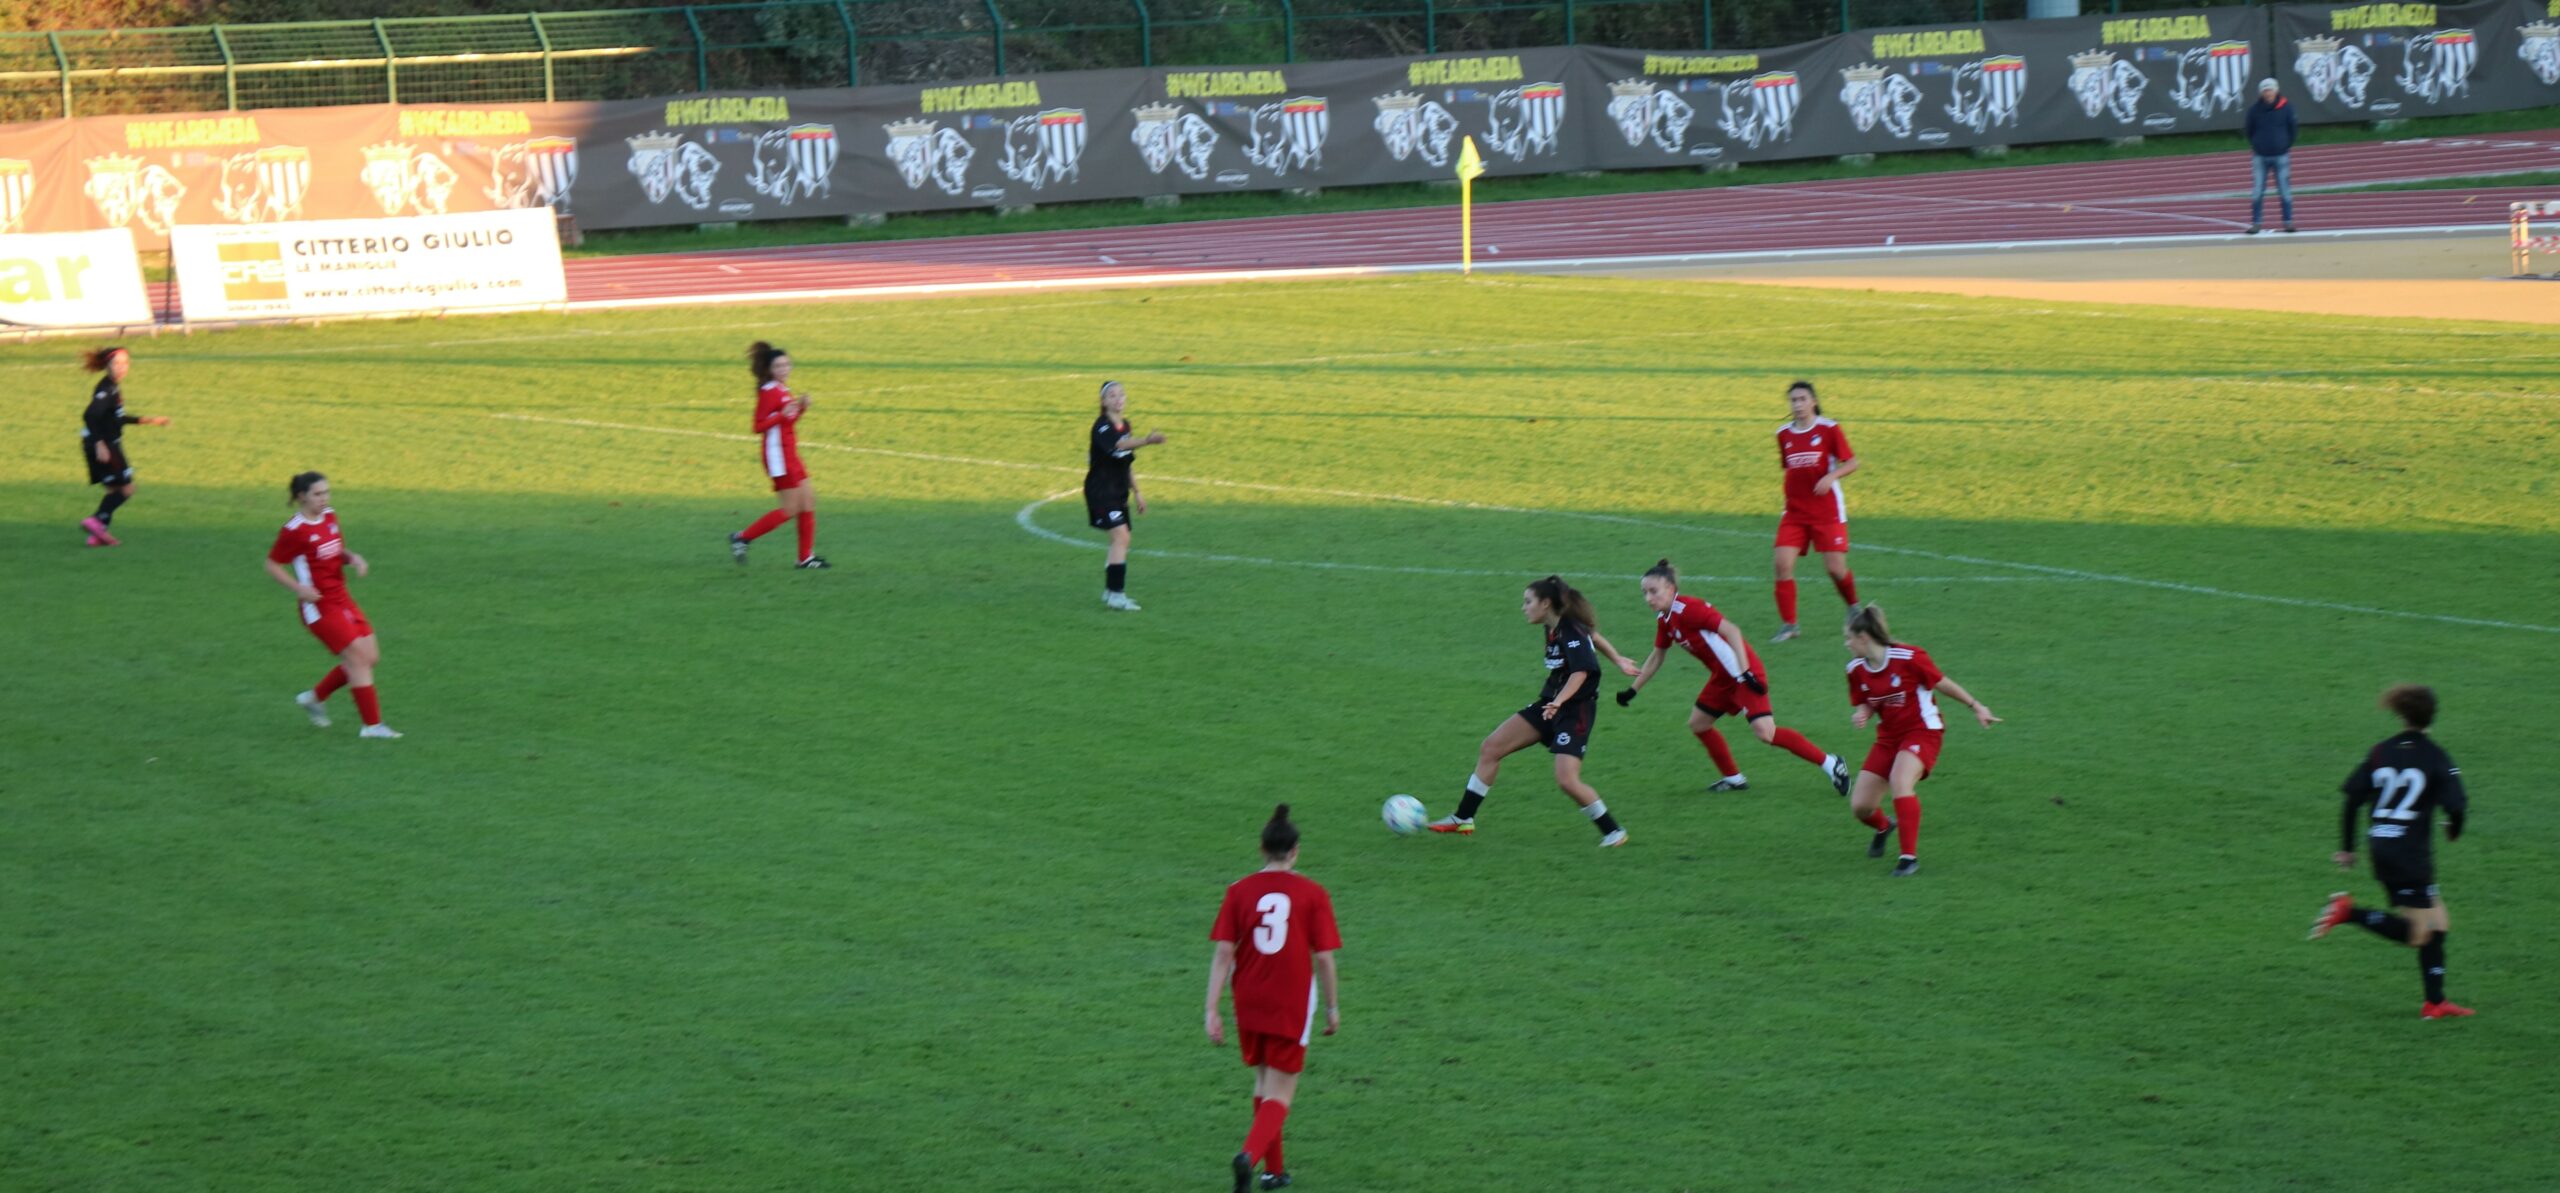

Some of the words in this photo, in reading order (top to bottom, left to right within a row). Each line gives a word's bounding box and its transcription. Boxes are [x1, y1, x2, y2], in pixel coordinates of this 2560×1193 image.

[294, 236, 410, 256] CITTERIO
[423, 229, 513, 250] GIULIO
[2371, 766, 2426, 820] 22
[1253, 892, 1291, 955] 3
